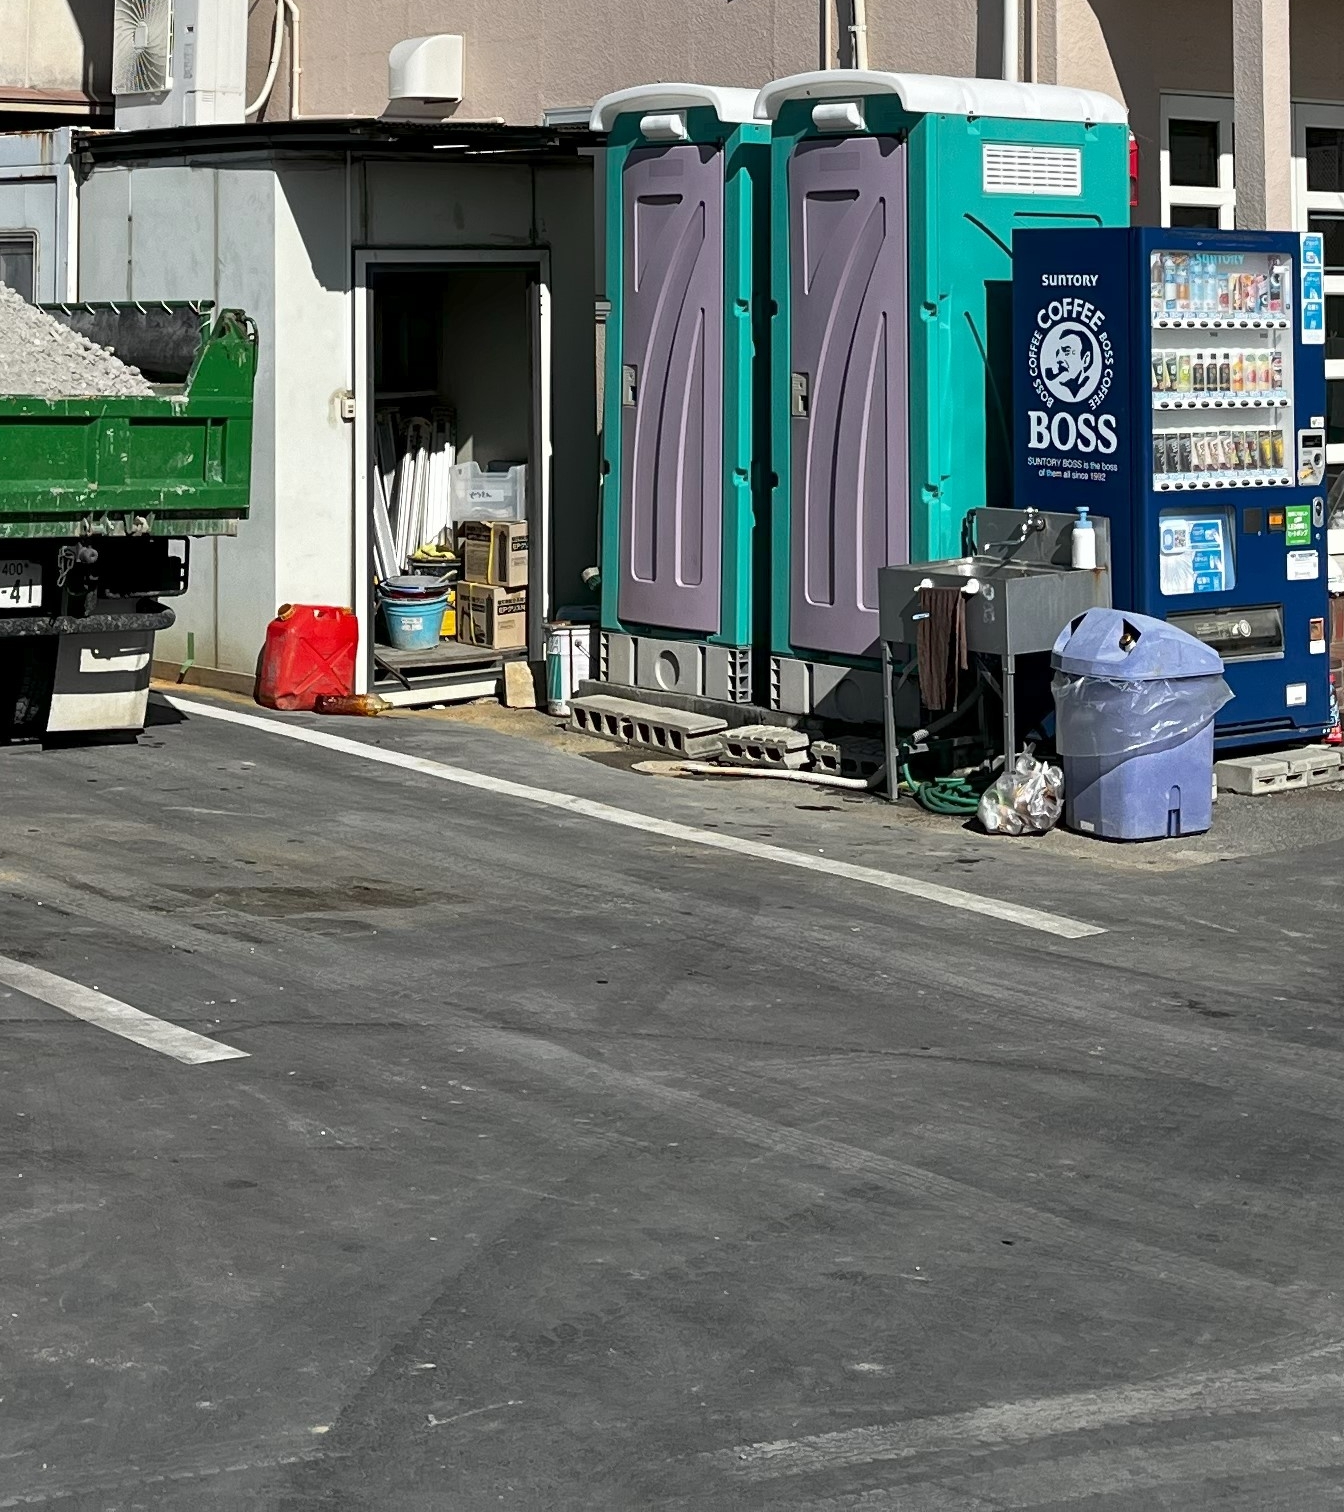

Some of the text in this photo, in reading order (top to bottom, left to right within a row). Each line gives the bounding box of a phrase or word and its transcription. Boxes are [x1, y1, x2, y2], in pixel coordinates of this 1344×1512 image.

[1042, 274, 1099, 286] SUNTORY
[1037, 297, 1106, 331] COFFEE
[1029, 330, 1054, 408] BOSS COFFEE
[1088, 332, 1114, 410] BOSS COFFEE
[1027, 410, 1118, 454] BOSS
[1027, 456, 1118, 472] SUNTORY BOSS is the boss
[1038, 468, 1046, 477] of
[1046, 469, 1062, 478] them
[1063, 470, 1071, 479] all
[1072, 471, 1089, 480] since
